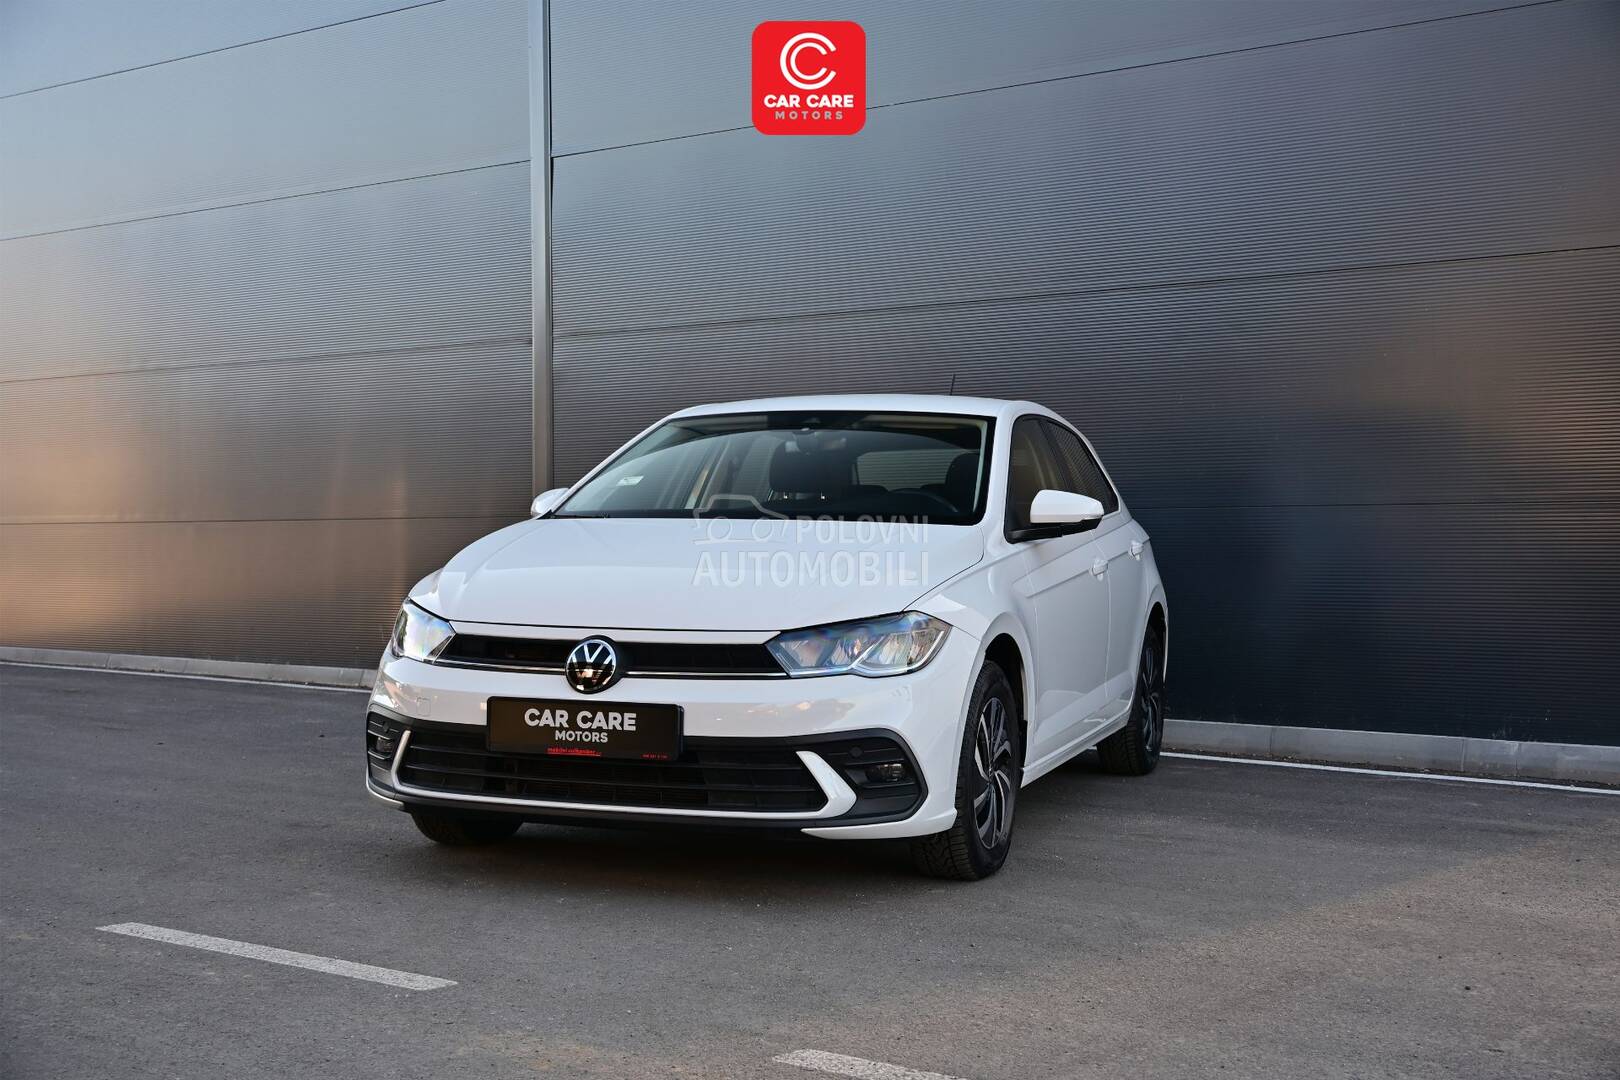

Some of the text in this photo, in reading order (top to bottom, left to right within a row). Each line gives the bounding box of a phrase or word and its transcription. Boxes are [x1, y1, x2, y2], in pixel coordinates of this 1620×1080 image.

[524, 708, 637, 731] CAR CARE
[555, 730, 608, 743] MOTORS
